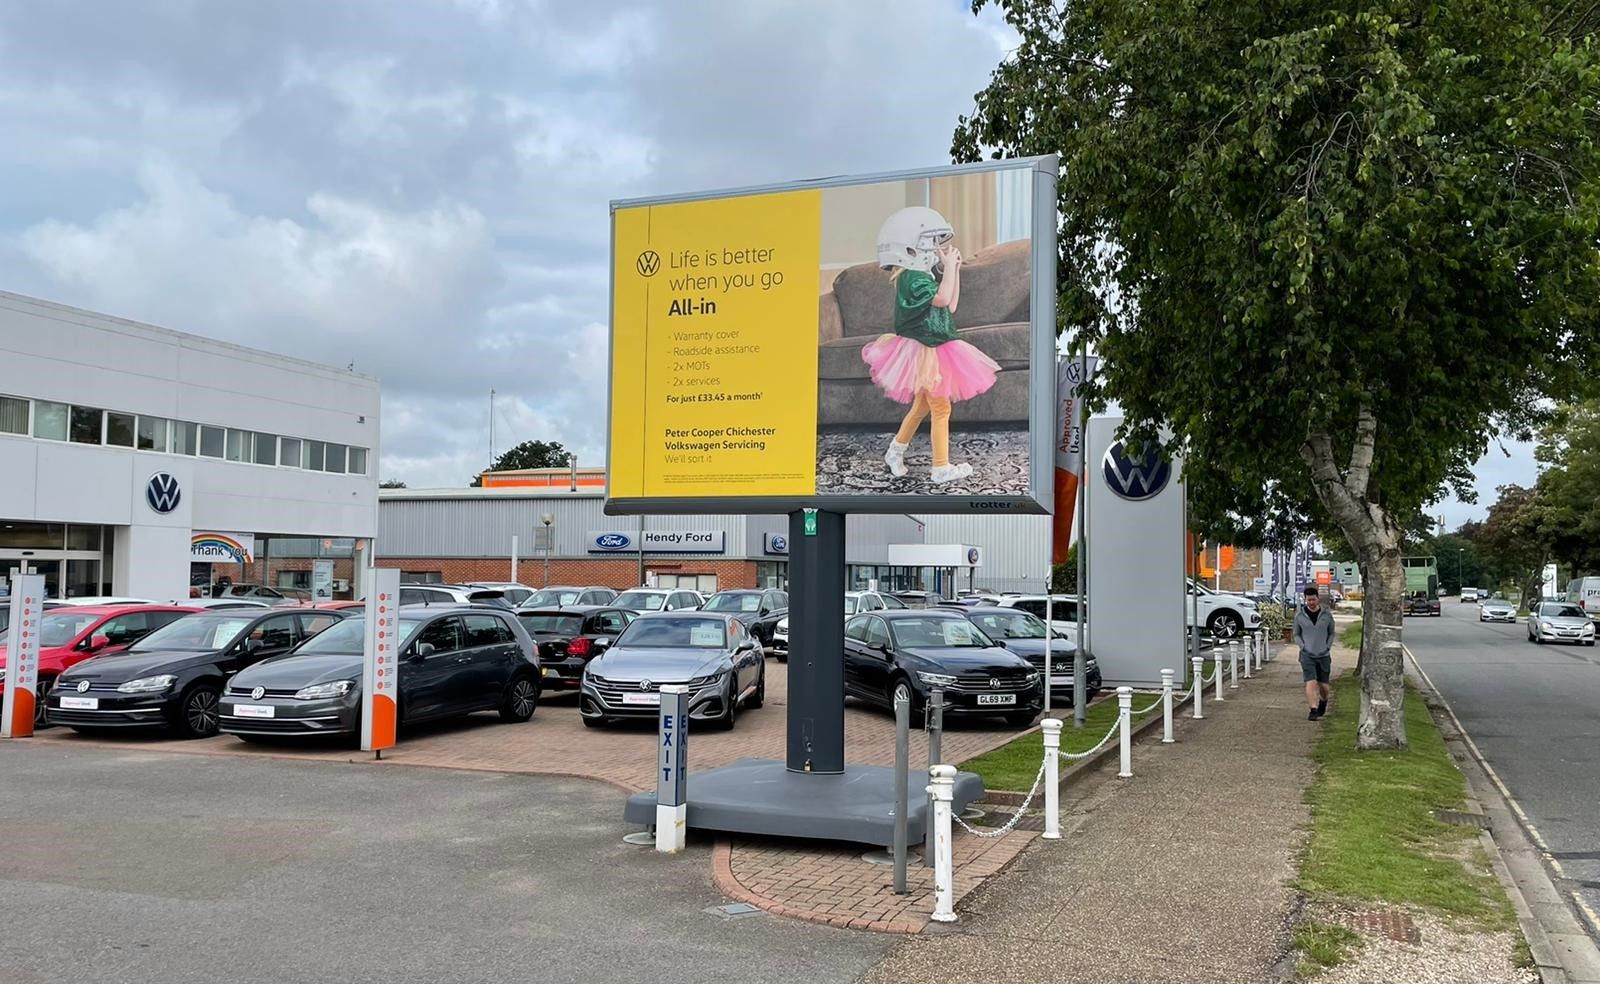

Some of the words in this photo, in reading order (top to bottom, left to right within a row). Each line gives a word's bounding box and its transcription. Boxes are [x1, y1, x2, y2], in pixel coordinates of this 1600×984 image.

[670, 250, 700, 269] Life
[705, 250, 717, 266] is
[723, 248, 775, 265] better
[669, 274, 717, 291] when
[723, 274, 754, 293] you
[761, 271, 783, 290] go
[668, 297, 716, 316] All-in
[673, 331, 713, 342] Warranty
[716, 330, 740, 340] cover
[673, 346, 712, 357] Roadside
[714, 345, 760, 355] assistance
[673, 362, 683, 371] 2x
[686, 361, 710, 371] MOTs
[673, 377, 683, 387] 2x
[686, 377, 720, 387] services
[666, 394, 680, 403] For
[680, 394, 696, 404] just
[697, 393, 725, 402] £33.45
[1059, 399, 1073, 453] Approved
[1070, 426, 1080, 454] Used
[665, 428, 690, 438] Peter
[691, 428, 725, 439] Cooper
[725, 427, 776, 437] Chichester
[665, 441, 720, 452] Volkswagen
[722, 440, 765, 451] Servicing
[664, 455, 686, 464] We'll
[687, 455, 704, 464] sort
[706, 455, 712, 463] it
[970, 501, 1011, 509] trotter
[645, 533, 682, 543] Hendy
[685, 533, 712, 542] Ford
[192, 544, 223, 556] Thank
[229, 547, 248, 559] you
[980, 695, 999, 703] GL69
[663, 715, 673, 781] EXIT
